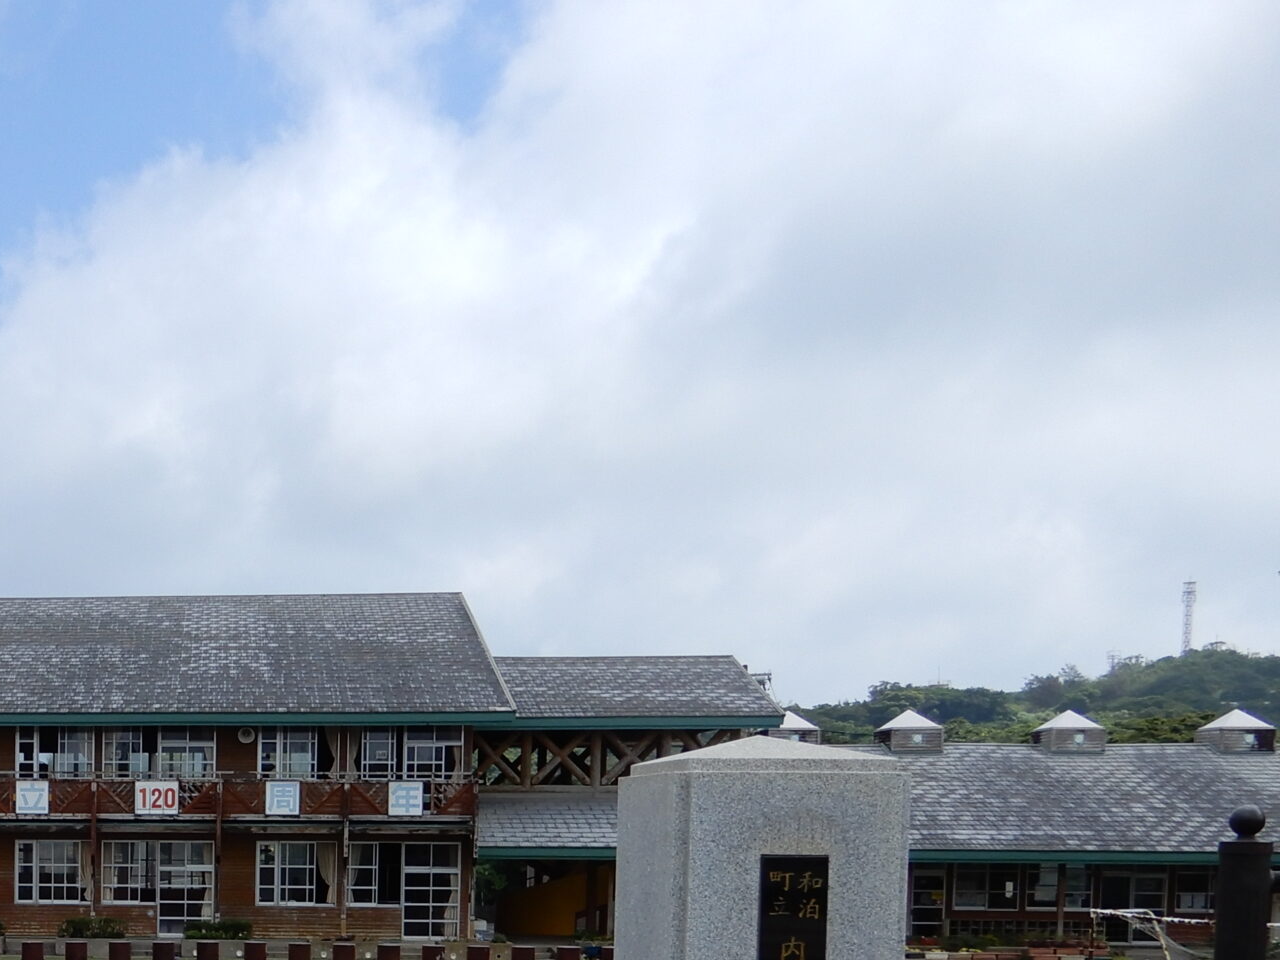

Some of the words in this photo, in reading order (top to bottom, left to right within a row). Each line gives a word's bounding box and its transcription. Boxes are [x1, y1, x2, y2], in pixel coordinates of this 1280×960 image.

[18, 783, 47, 811] 立
[138, 787, 177, 809] 120
[267, 784, 298, 814] 周
[390, 785, 422, 813] 年
[768, 870, 795, 916] 町立
[797, 871, 824, 920] 和泊
